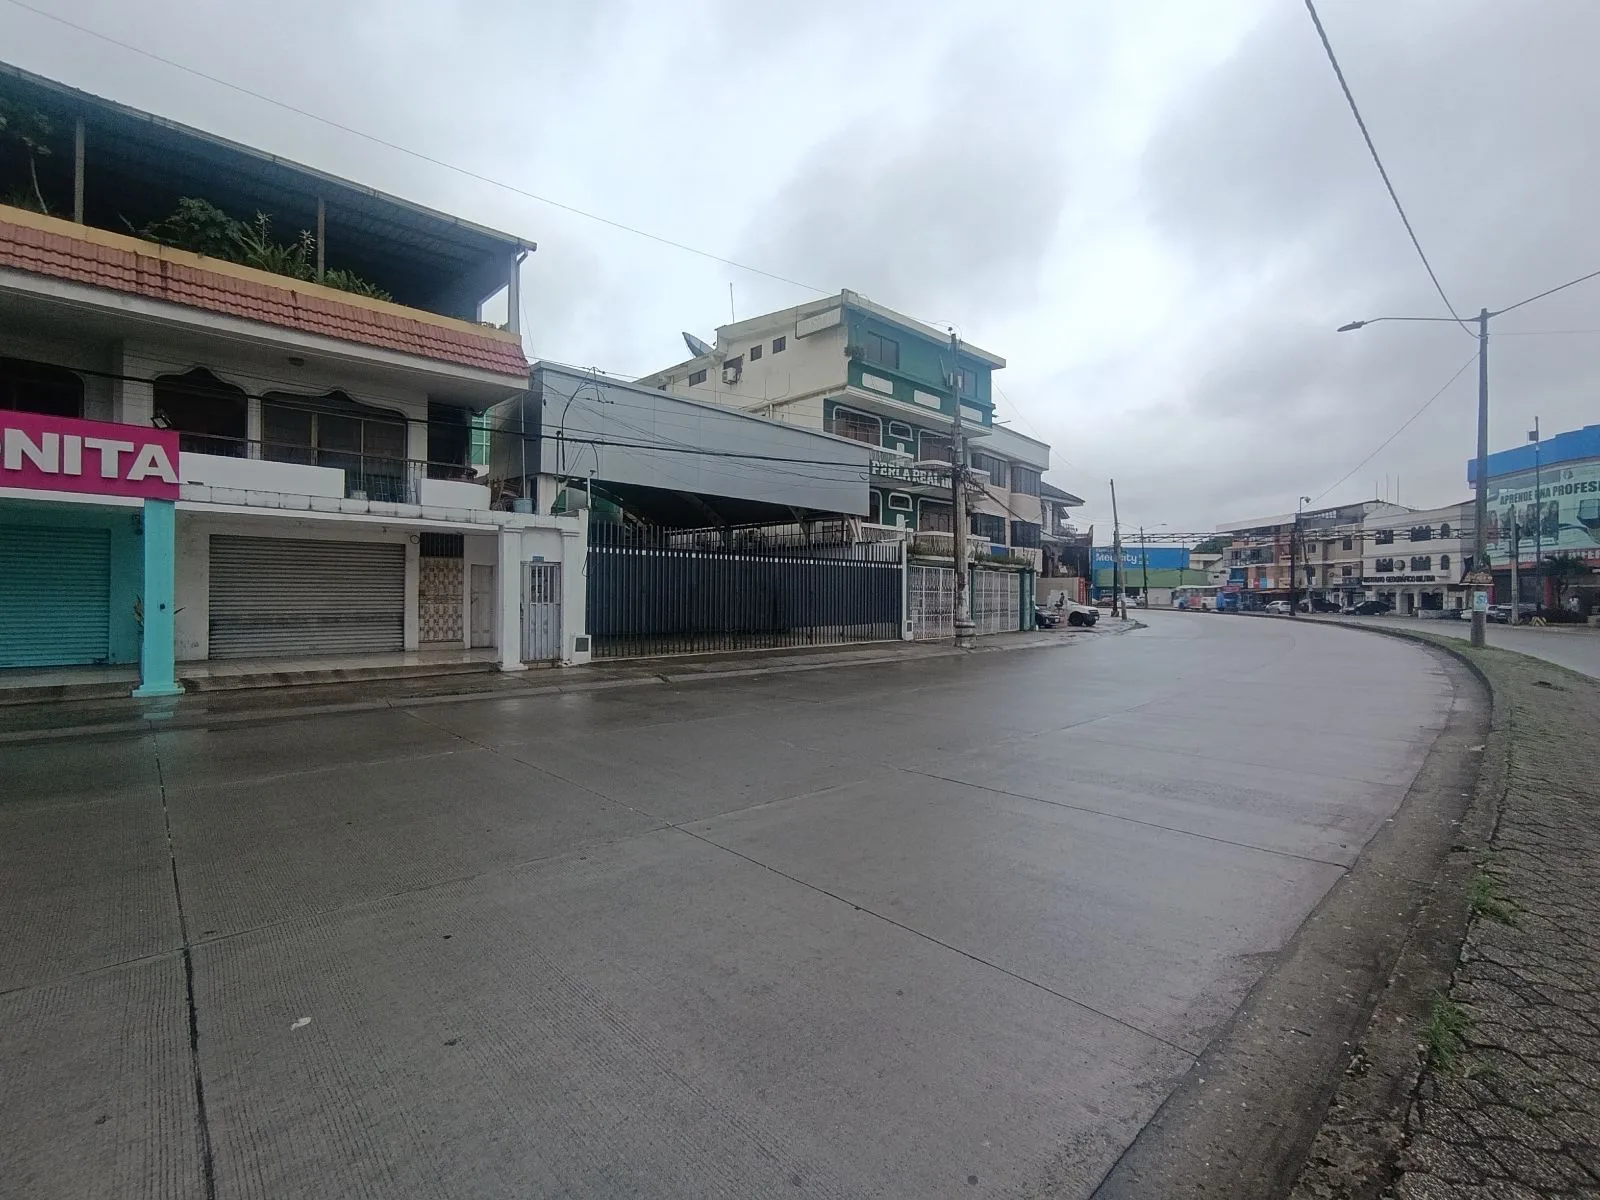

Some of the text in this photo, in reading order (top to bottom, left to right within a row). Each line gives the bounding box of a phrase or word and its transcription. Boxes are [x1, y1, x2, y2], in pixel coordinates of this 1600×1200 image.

[0, 428, 178, 483] NITA
[913, 469, 941, 487] REAL
[1500, 490, 1533, 505] APRENDE
